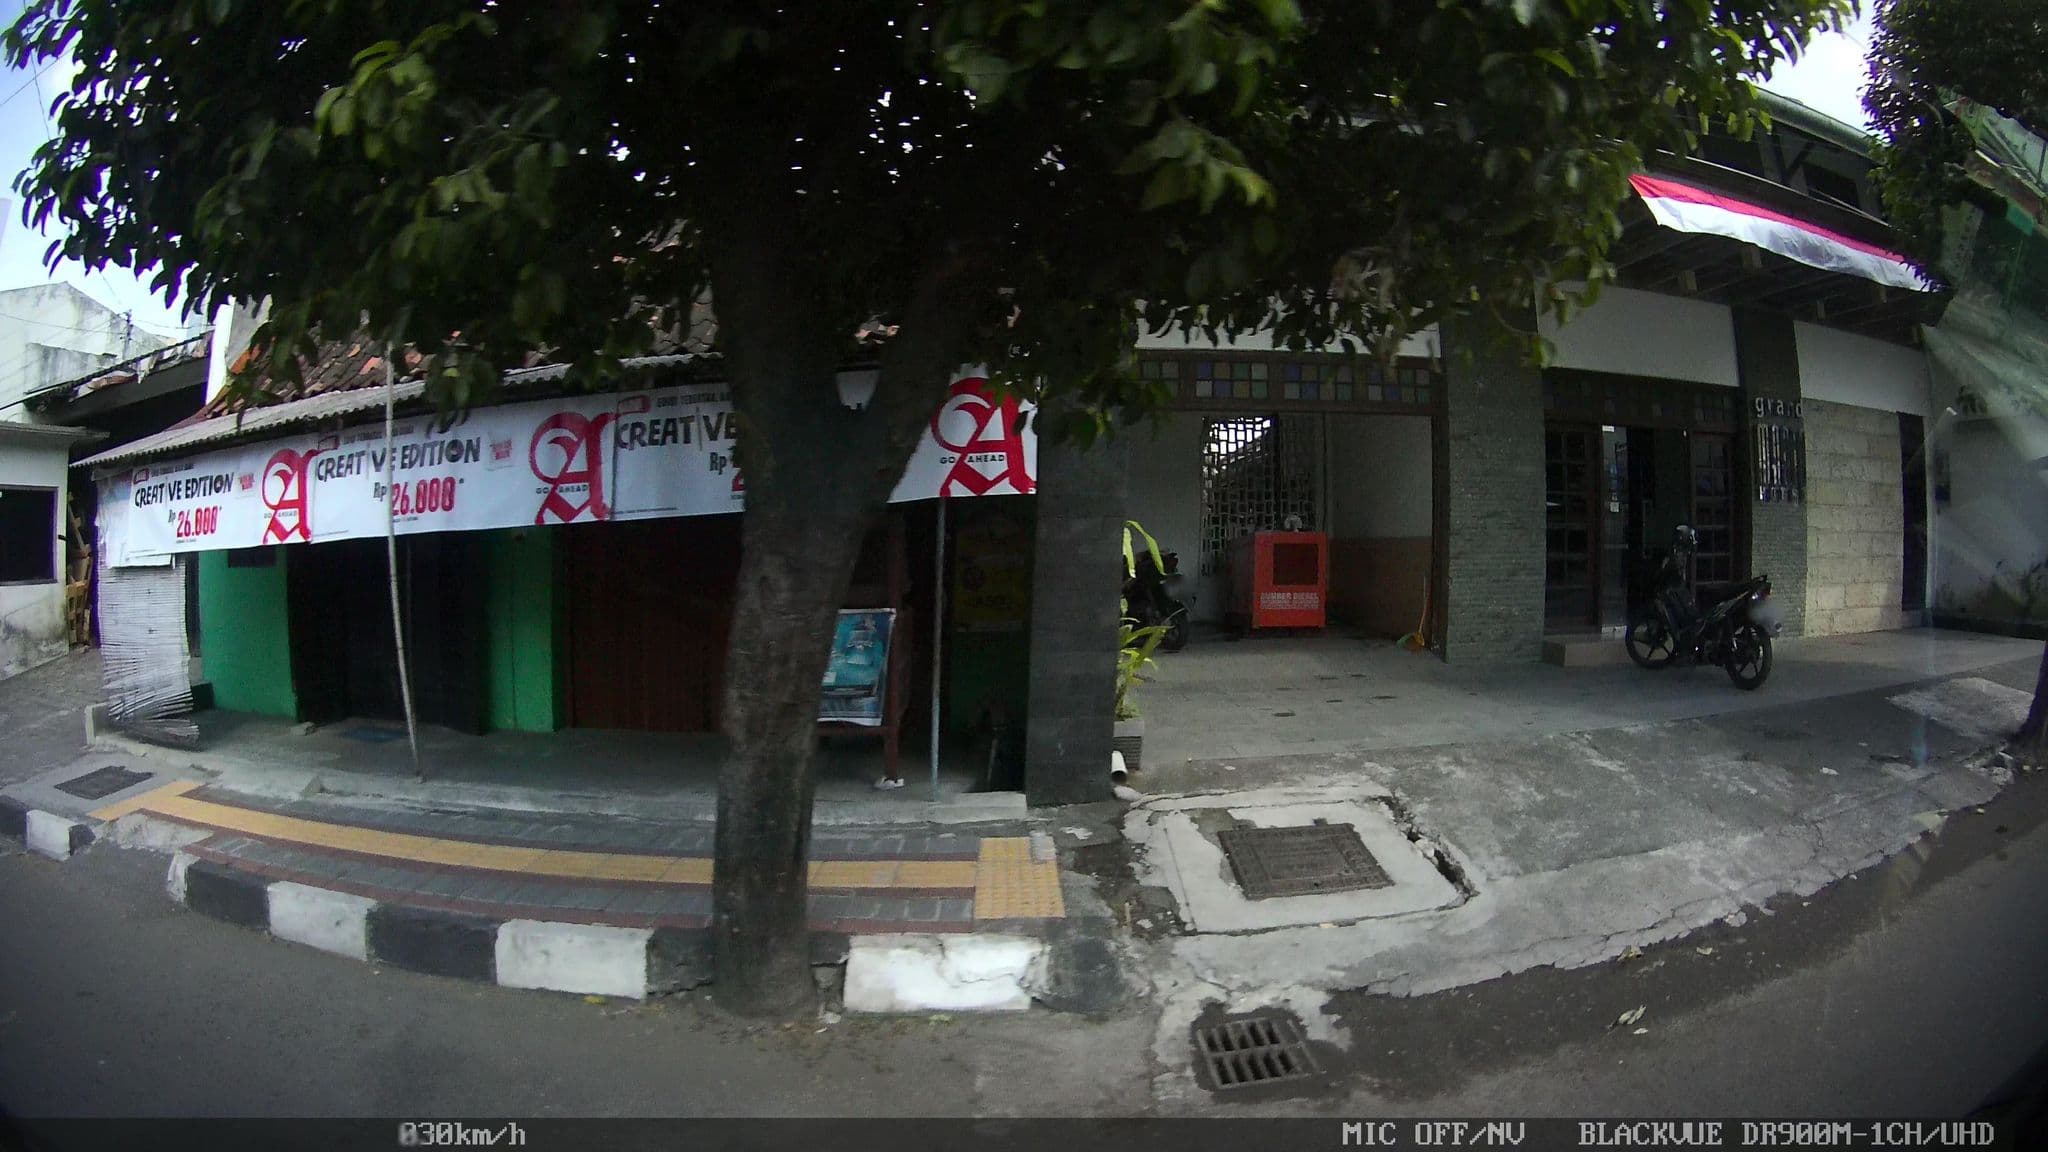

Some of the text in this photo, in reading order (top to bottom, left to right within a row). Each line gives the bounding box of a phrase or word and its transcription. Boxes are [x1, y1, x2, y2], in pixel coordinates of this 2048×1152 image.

[399, 436, 481, 470] EDITION
[709, 451, 727, 475] Rp
[939, 454, 1005, 464] GO AHEAD
[185, 472, 235, 499] EDITION
[373, 481, 388, 502] Rp
[535, 484, 589, 495] GO AHEAD
